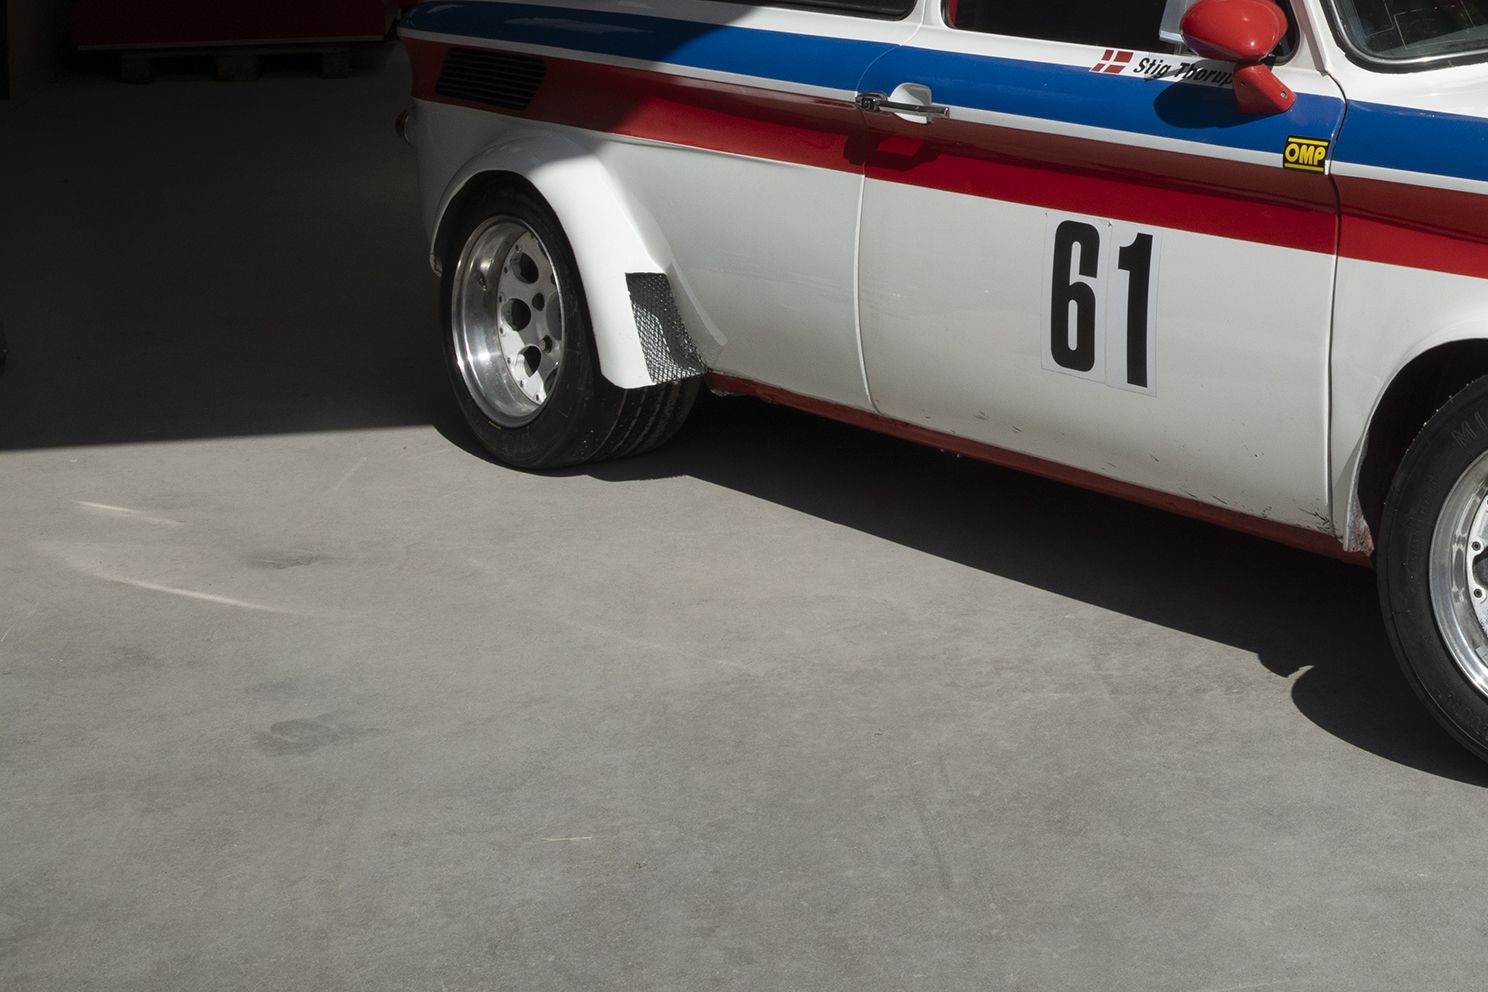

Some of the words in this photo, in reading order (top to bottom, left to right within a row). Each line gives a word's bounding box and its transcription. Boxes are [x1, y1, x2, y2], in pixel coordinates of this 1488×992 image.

[1132, 58, 1170, 80] Stig
[1174, 61, 1234, 86] Thorup
[1284, 143, 1326, 166] OMP
[1050, 220, 1153, 388] 61
